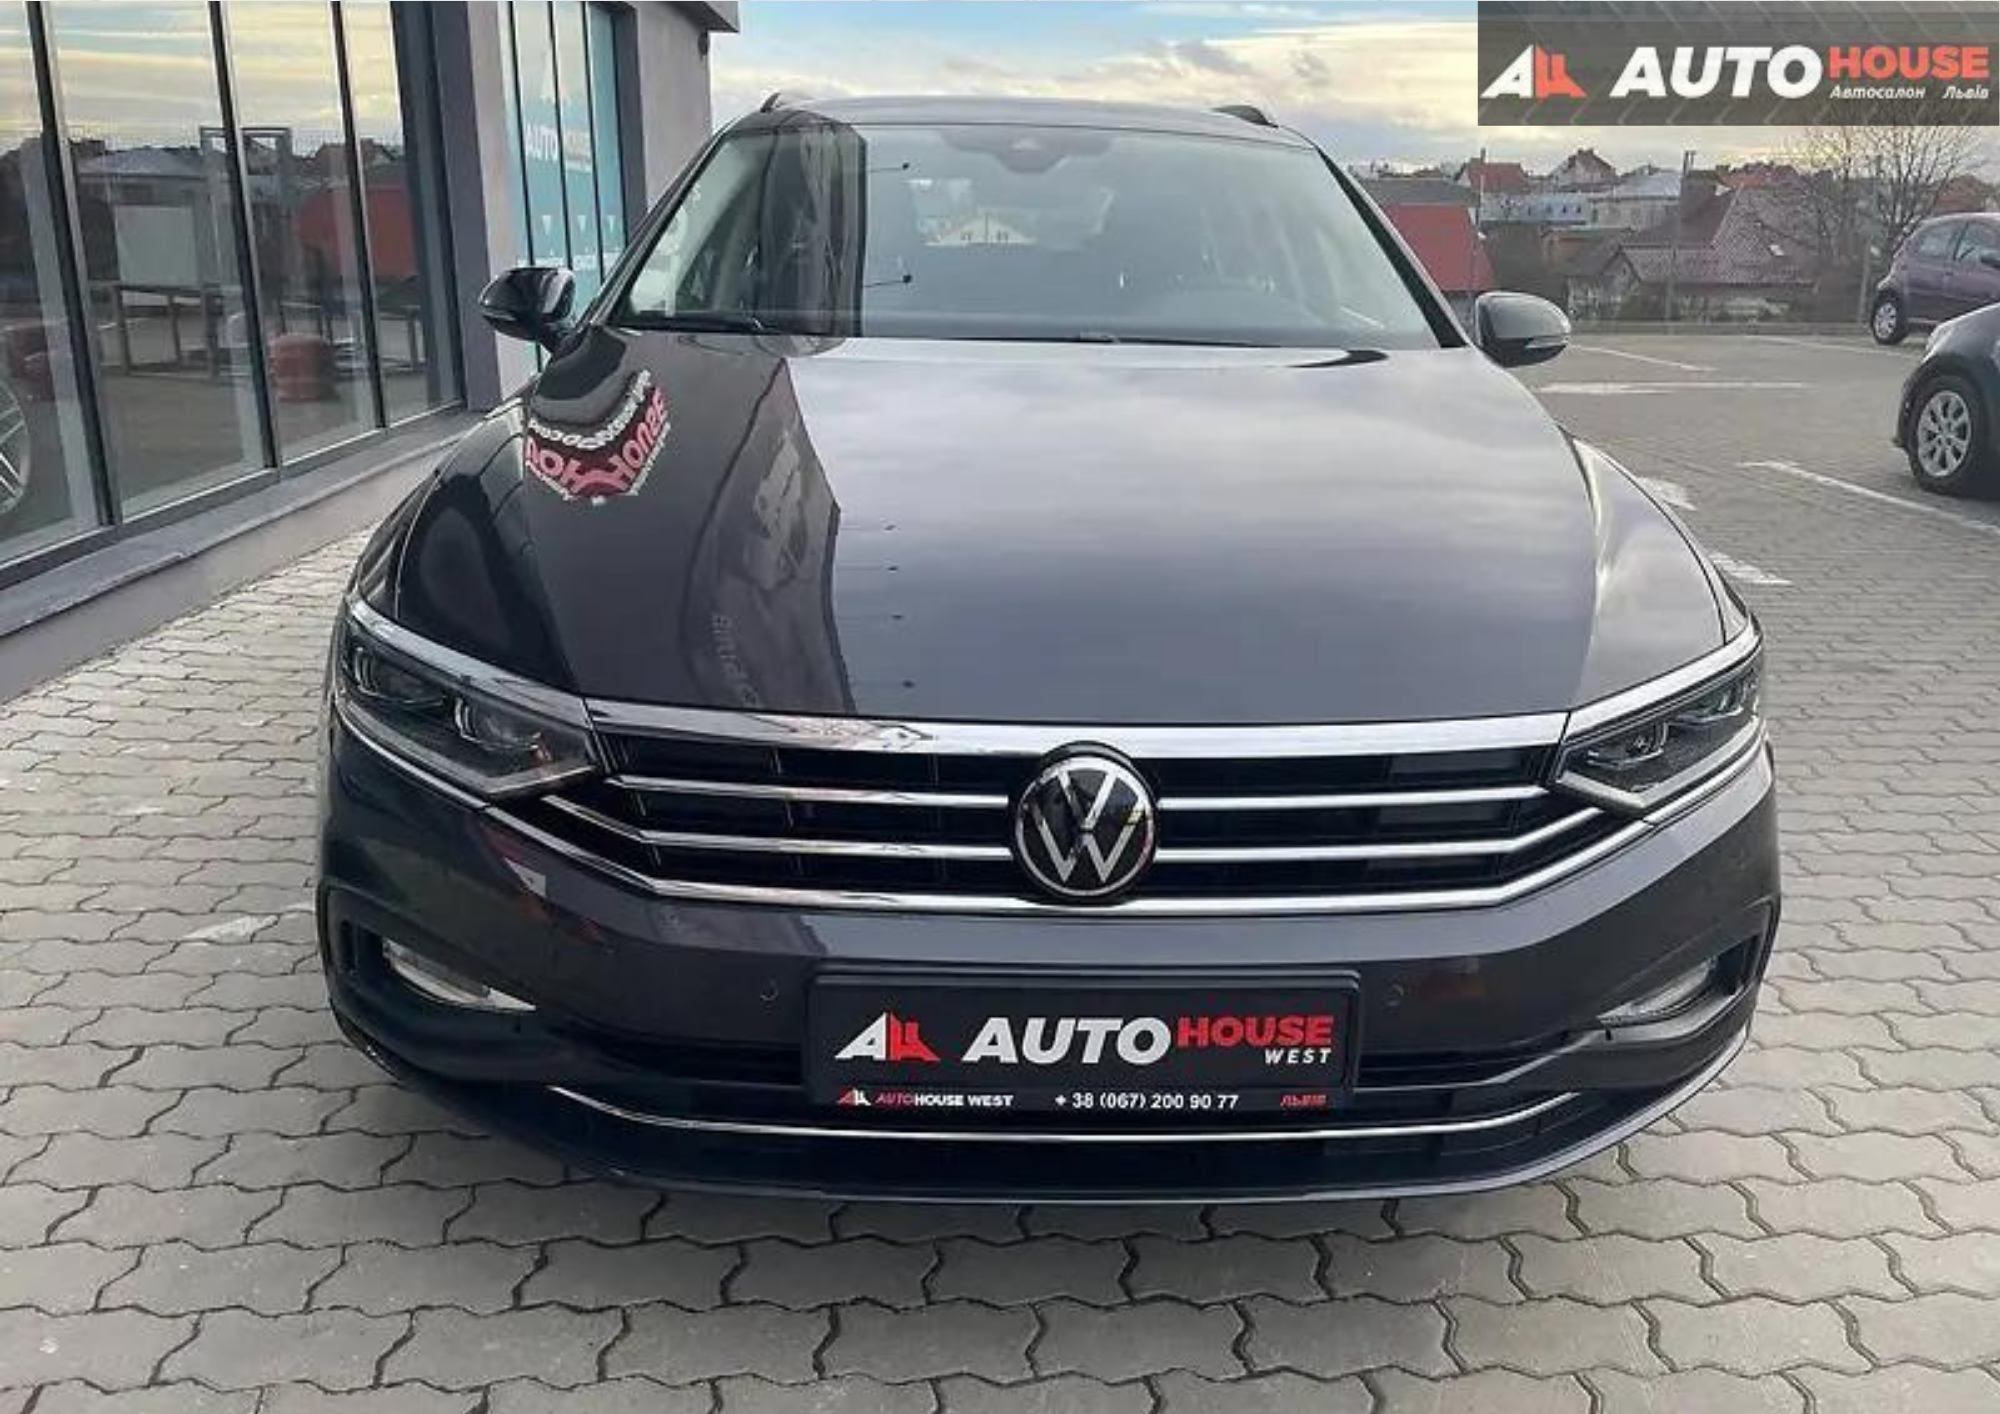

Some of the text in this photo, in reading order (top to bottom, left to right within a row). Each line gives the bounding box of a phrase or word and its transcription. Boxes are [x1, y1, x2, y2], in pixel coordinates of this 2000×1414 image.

[961, 1015, 1335, 1065] AUTO HOUSE
[1264, 1048, 1333, 1065] WEST
[968, 1094, 1014, 1107] WEST
[1072, 1092, 1094, 1109] 38
[1100, 1092, 1147, 1109] (067)
[1150, 1093, 1185, 1109] 200
[1190, 1094, 1212, 1109] 90
[1217, 1095, 1239, 1109] 77
